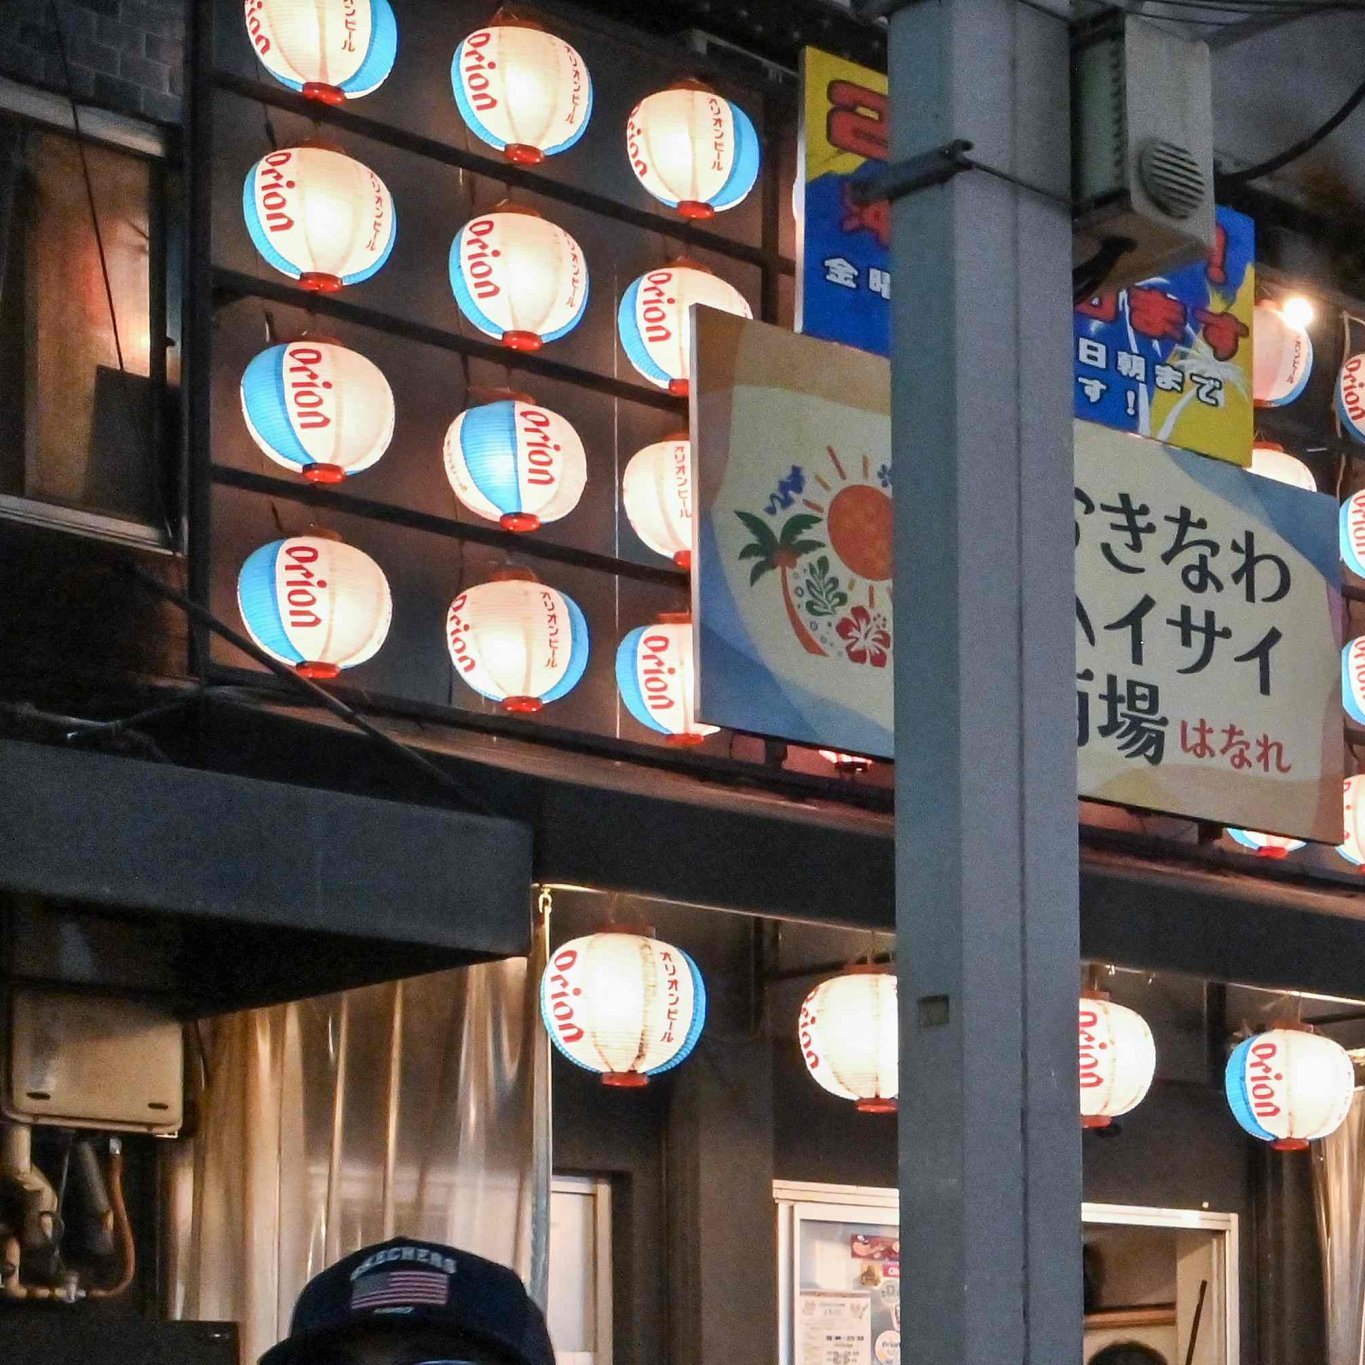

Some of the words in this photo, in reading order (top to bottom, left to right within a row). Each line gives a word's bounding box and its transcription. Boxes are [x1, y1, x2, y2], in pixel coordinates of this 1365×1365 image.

[465, 32, 497, 111] Orion
[708, 97, 725, 172] オリオンビール
[261, 152, 296, 233] Orion
[466, 219, 501, 300] Orion
[643, 271, 677, 344] Orion
[289, 348, 333, 430] Orion
[1078, 337, 1226, 408] 日朝まで
[519, 409, 562, 486] Orion
[674, 446, 693, 519] オリオンビール
[284, 545, 328, 629] Orion
[449, 593, 477, 674] Orion
[539, 590, 559, 669] オリオンビール
[643, 634, 677, 711] Orion
[1180, 716, 1292, 775] はなれ
[551, 949, 584, 1045] Orion
[658, 951, 682, 1045] オリオンビール
[1247, 1041, 1283, 1119] Orion
